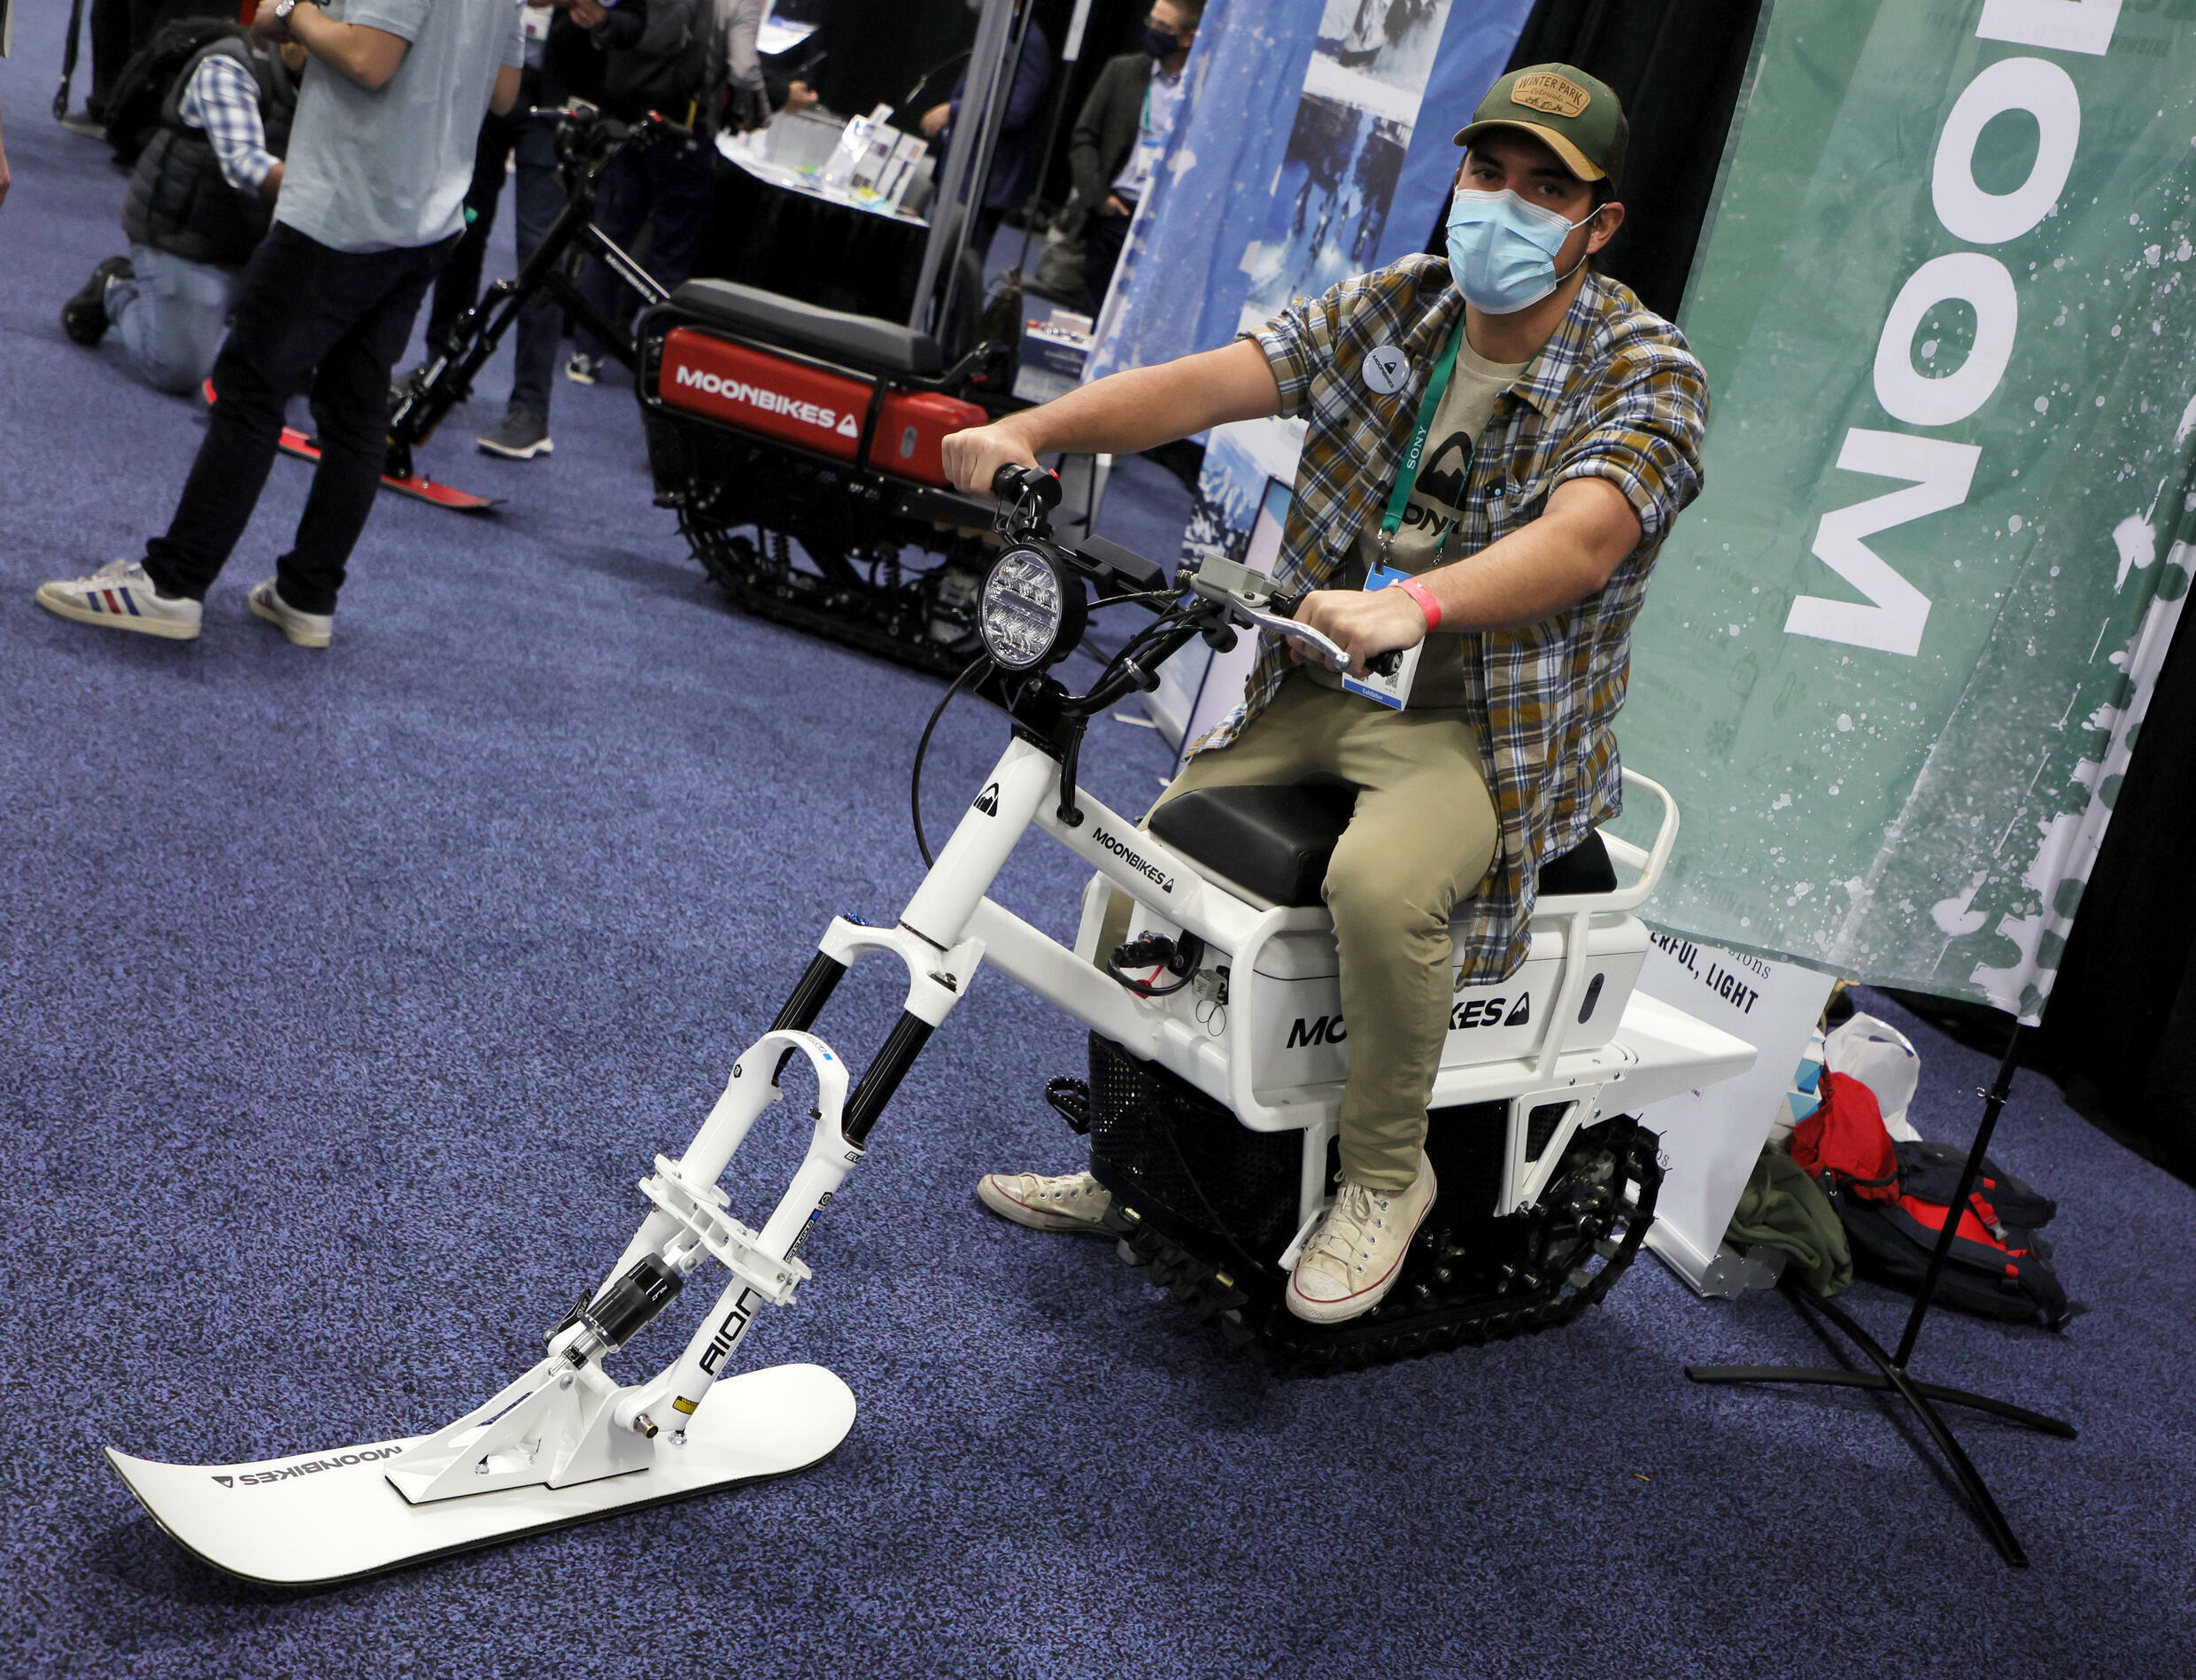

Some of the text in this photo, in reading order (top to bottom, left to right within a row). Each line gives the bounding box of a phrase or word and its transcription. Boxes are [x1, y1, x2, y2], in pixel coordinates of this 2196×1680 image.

[1518, 76, 1583, 105] WINTER PARK
[1372, 355, 1396, 389] MOONBIKES
[676, 365, 836, 429] MOONBIKES
[1406, 425, 1427, 469] SONY
[1092, 827, 1166, 885] MOONBIKES
[1705, 963, 1759, 1014] LIGHT
[238, 1445, 403, 1485] MOONBIKES
